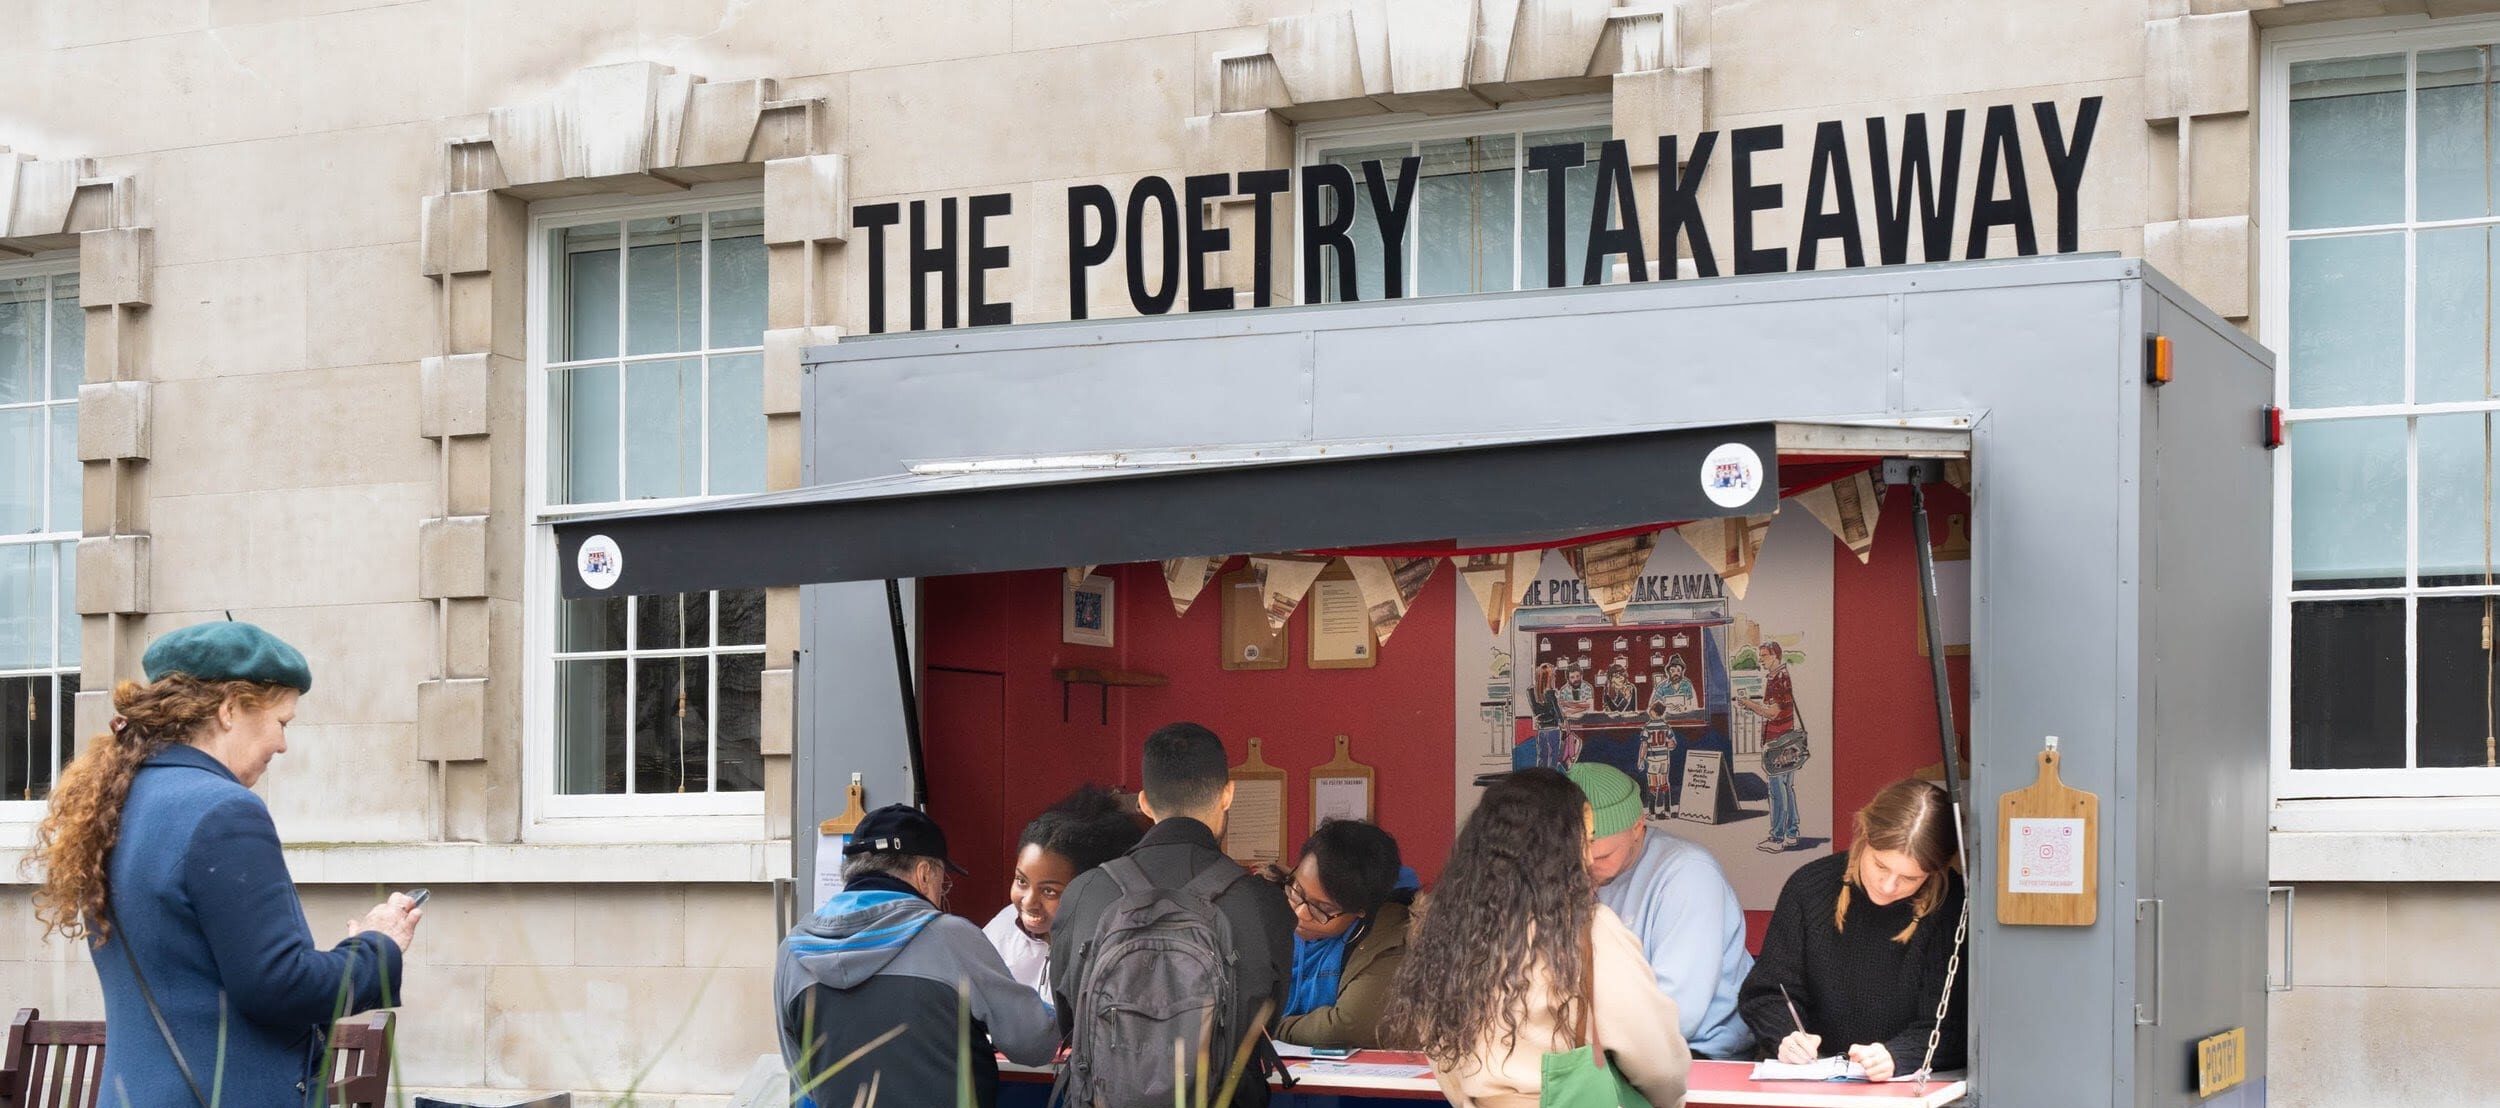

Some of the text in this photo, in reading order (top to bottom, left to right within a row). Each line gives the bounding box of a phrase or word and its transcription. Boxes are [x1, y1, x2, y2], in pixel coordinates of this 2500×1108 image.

[853, 96, 2103, 334] THE POETRY TAKEAWAY
[1628, 573, 1724, 602] AKEAWAY
[1651, 731, 1665, 746] 10
